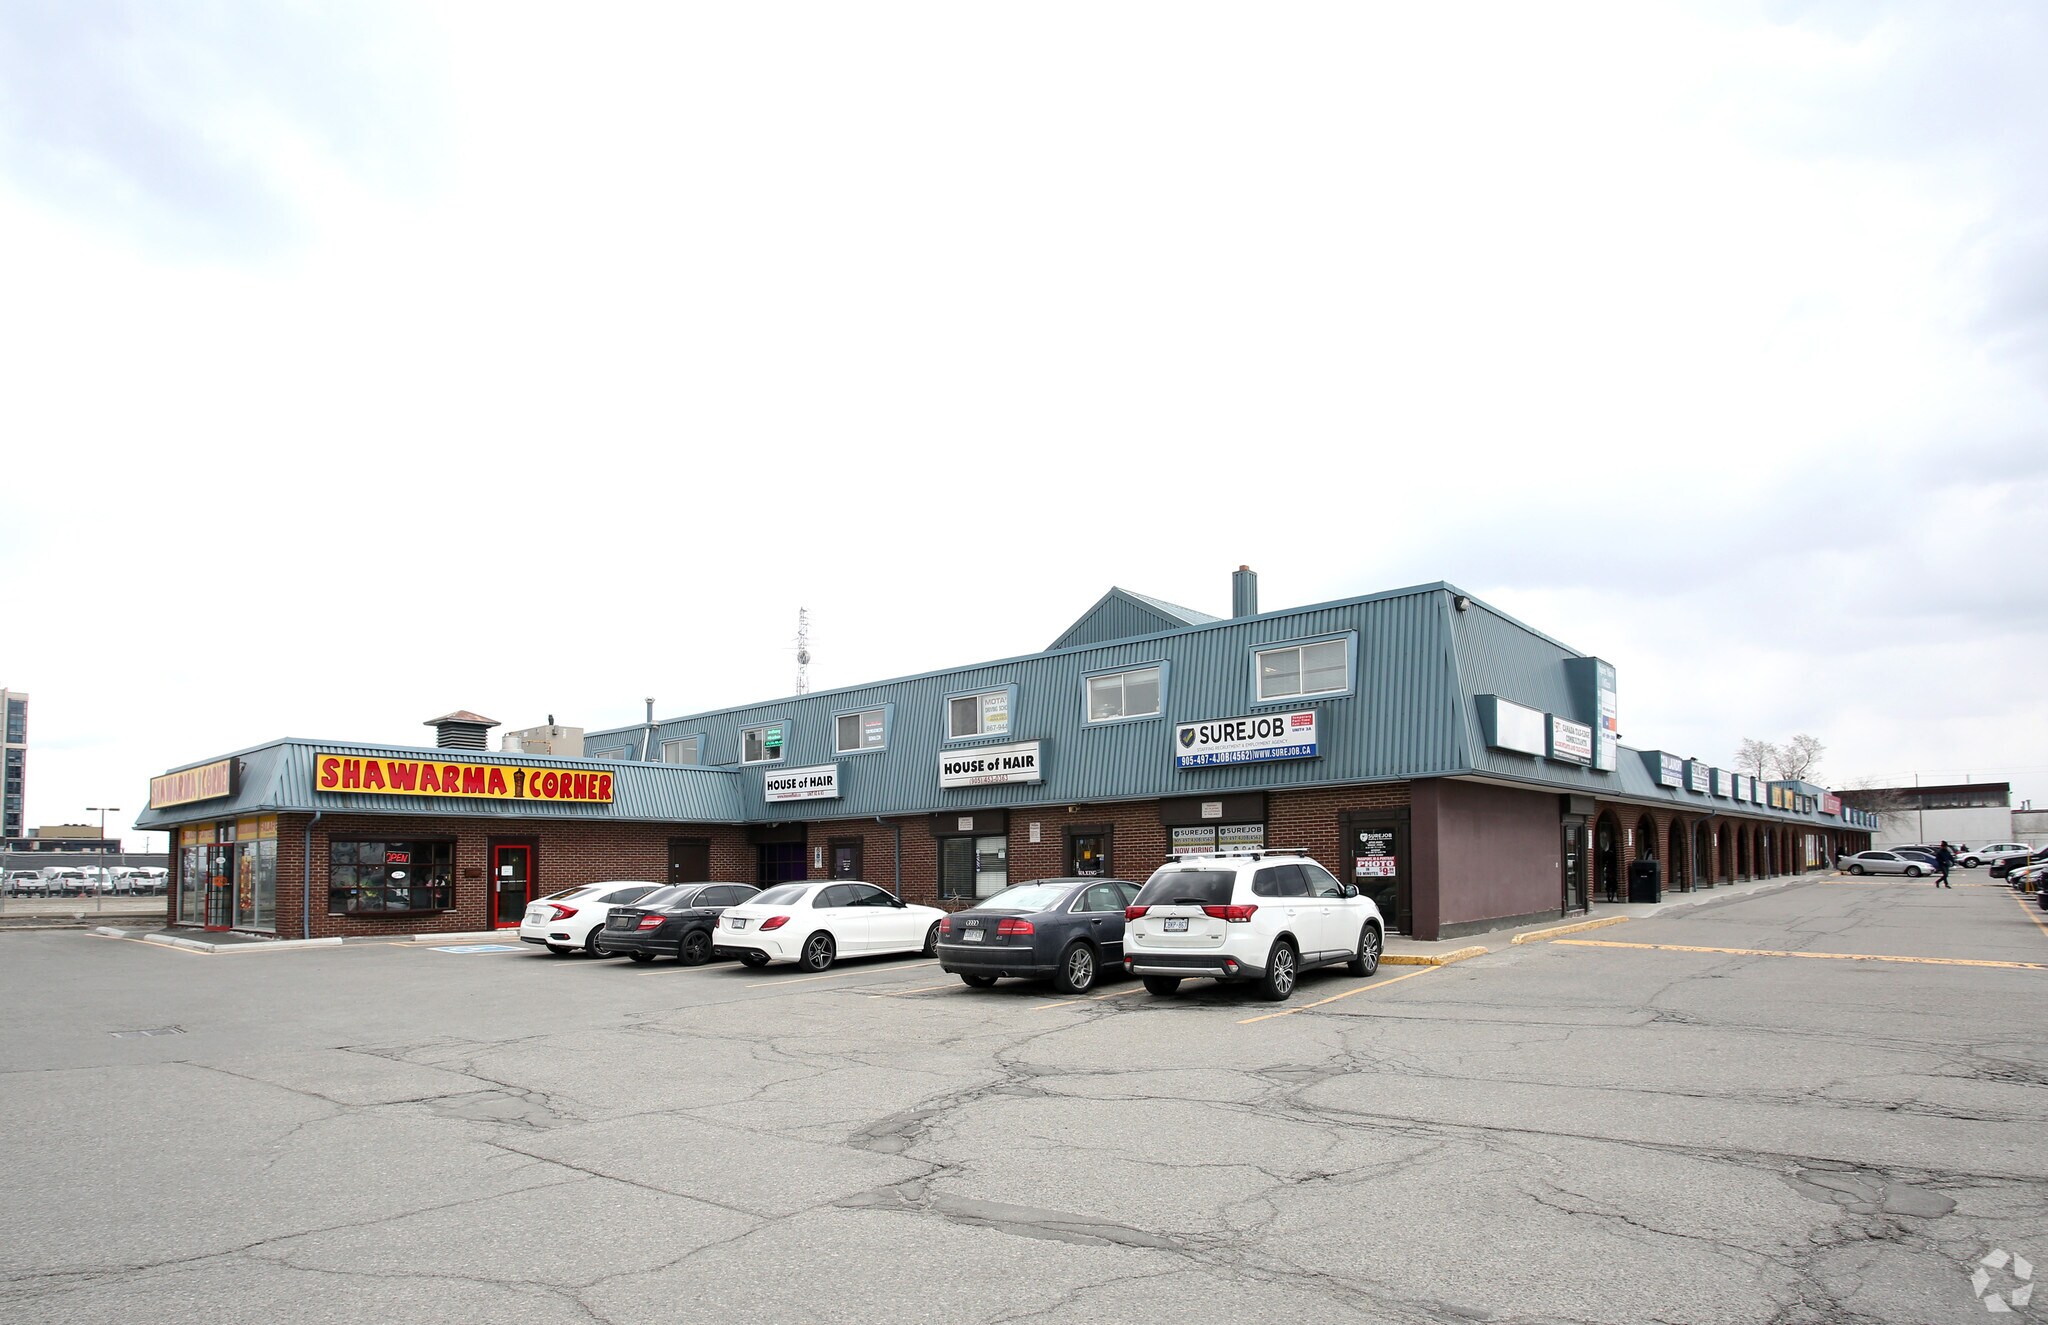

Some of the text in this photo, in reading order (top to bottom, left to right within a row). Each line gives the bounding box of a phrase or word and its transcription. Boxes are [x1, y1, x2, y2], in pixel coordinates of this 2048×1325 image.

[1200, 718, 1284, 744] SUREJOB
[944, 755, 1034, 774] HOUSE of HAIR
[152, 772, 196, 804] SHAWARMA
[321, 758, 611, 800] SHAWARMA CORNER
[767, 775, 833, 791] HOUSE of HAIR
[386, 852, 409, 863] OPEN
